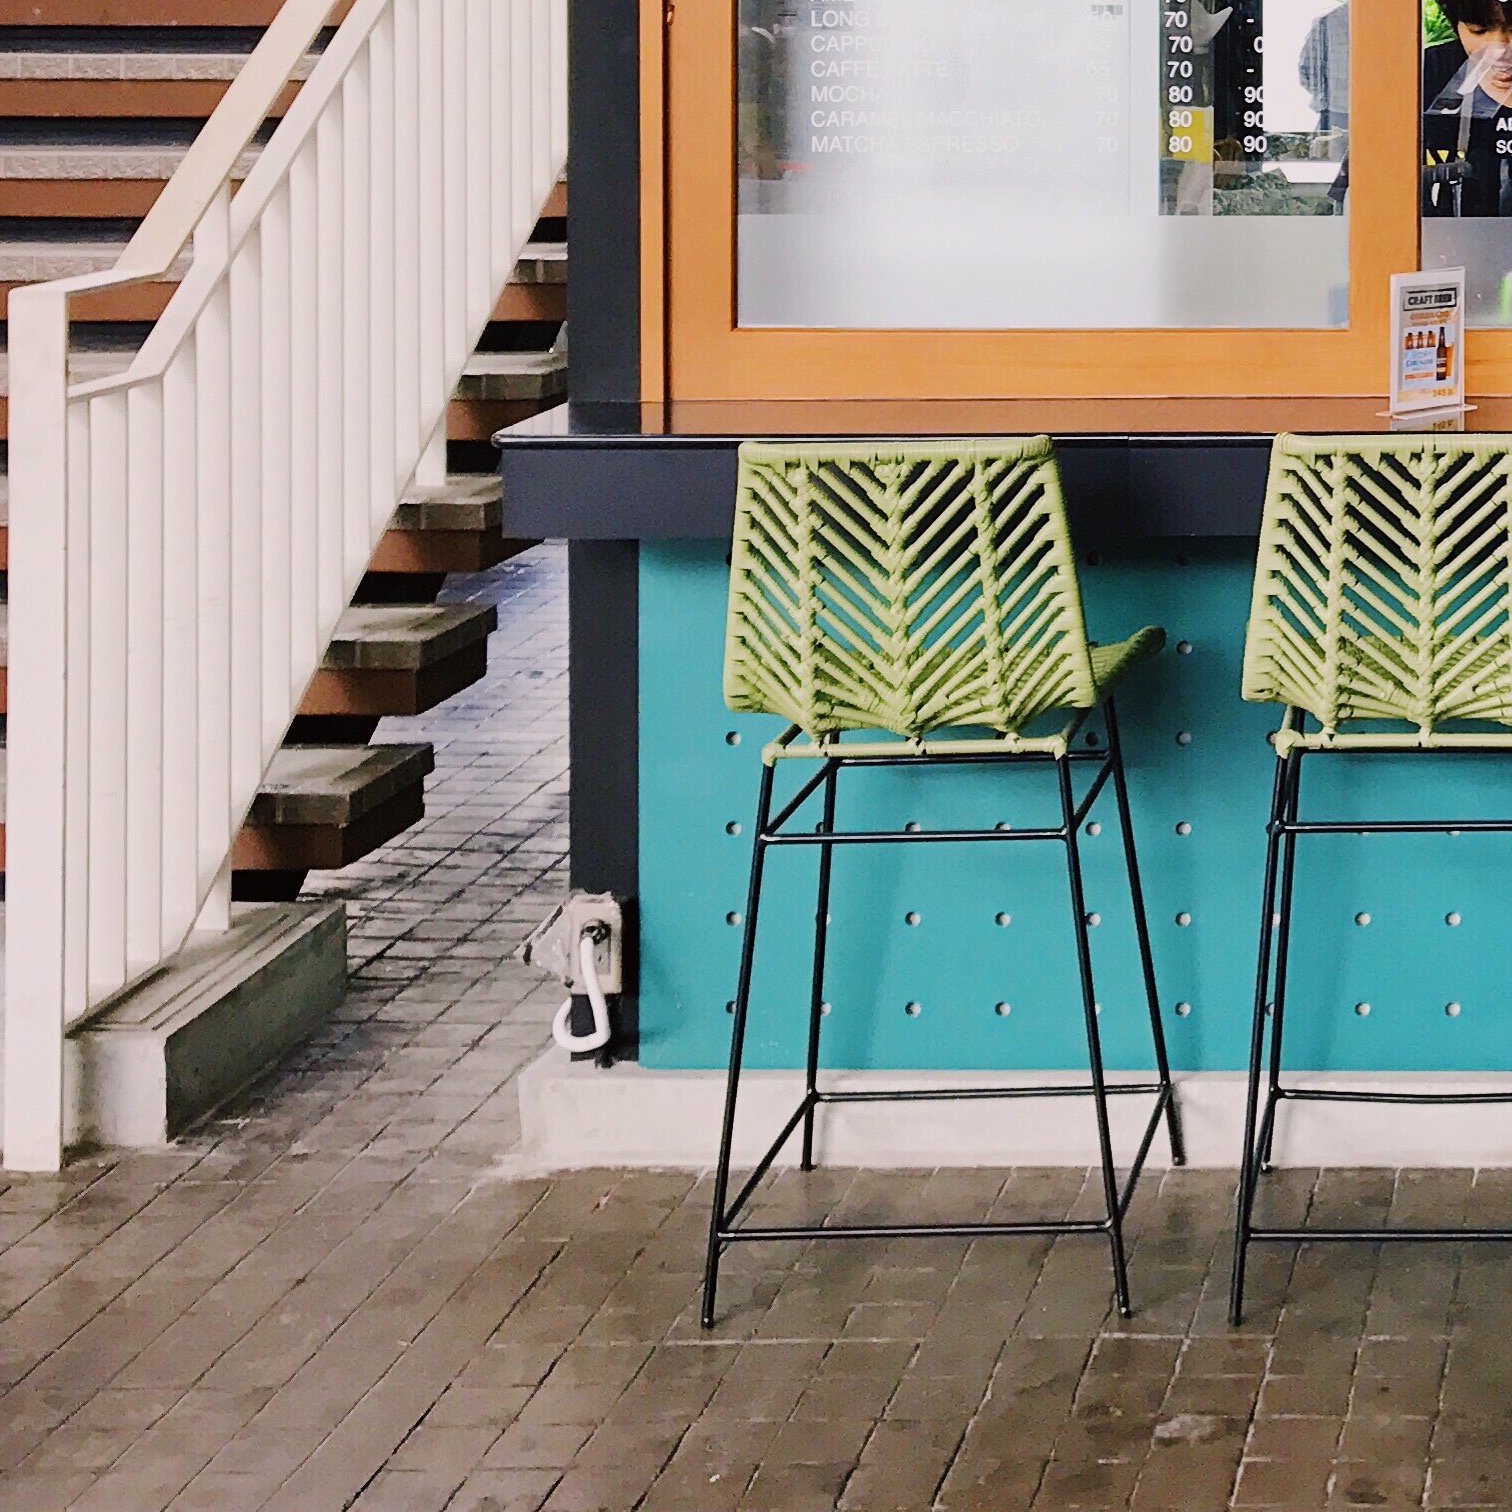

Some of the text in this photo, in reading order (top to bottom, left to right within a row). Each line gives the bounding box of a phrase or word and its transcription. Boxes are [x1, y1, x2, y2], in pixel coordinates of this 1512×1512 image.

[810, 10, 869, 28] LONG
[1164, 11, 1188, 28] 70
[1169, 36, 1193, 53] 70
[1167, 61, 1193, 78] 70
[1169, 86, 1193, 103] 80
[1169, 111, 1193, 128] 80
[1169, 136, 1193, 153] 80
[1244, 136, 1267, 153] 90
